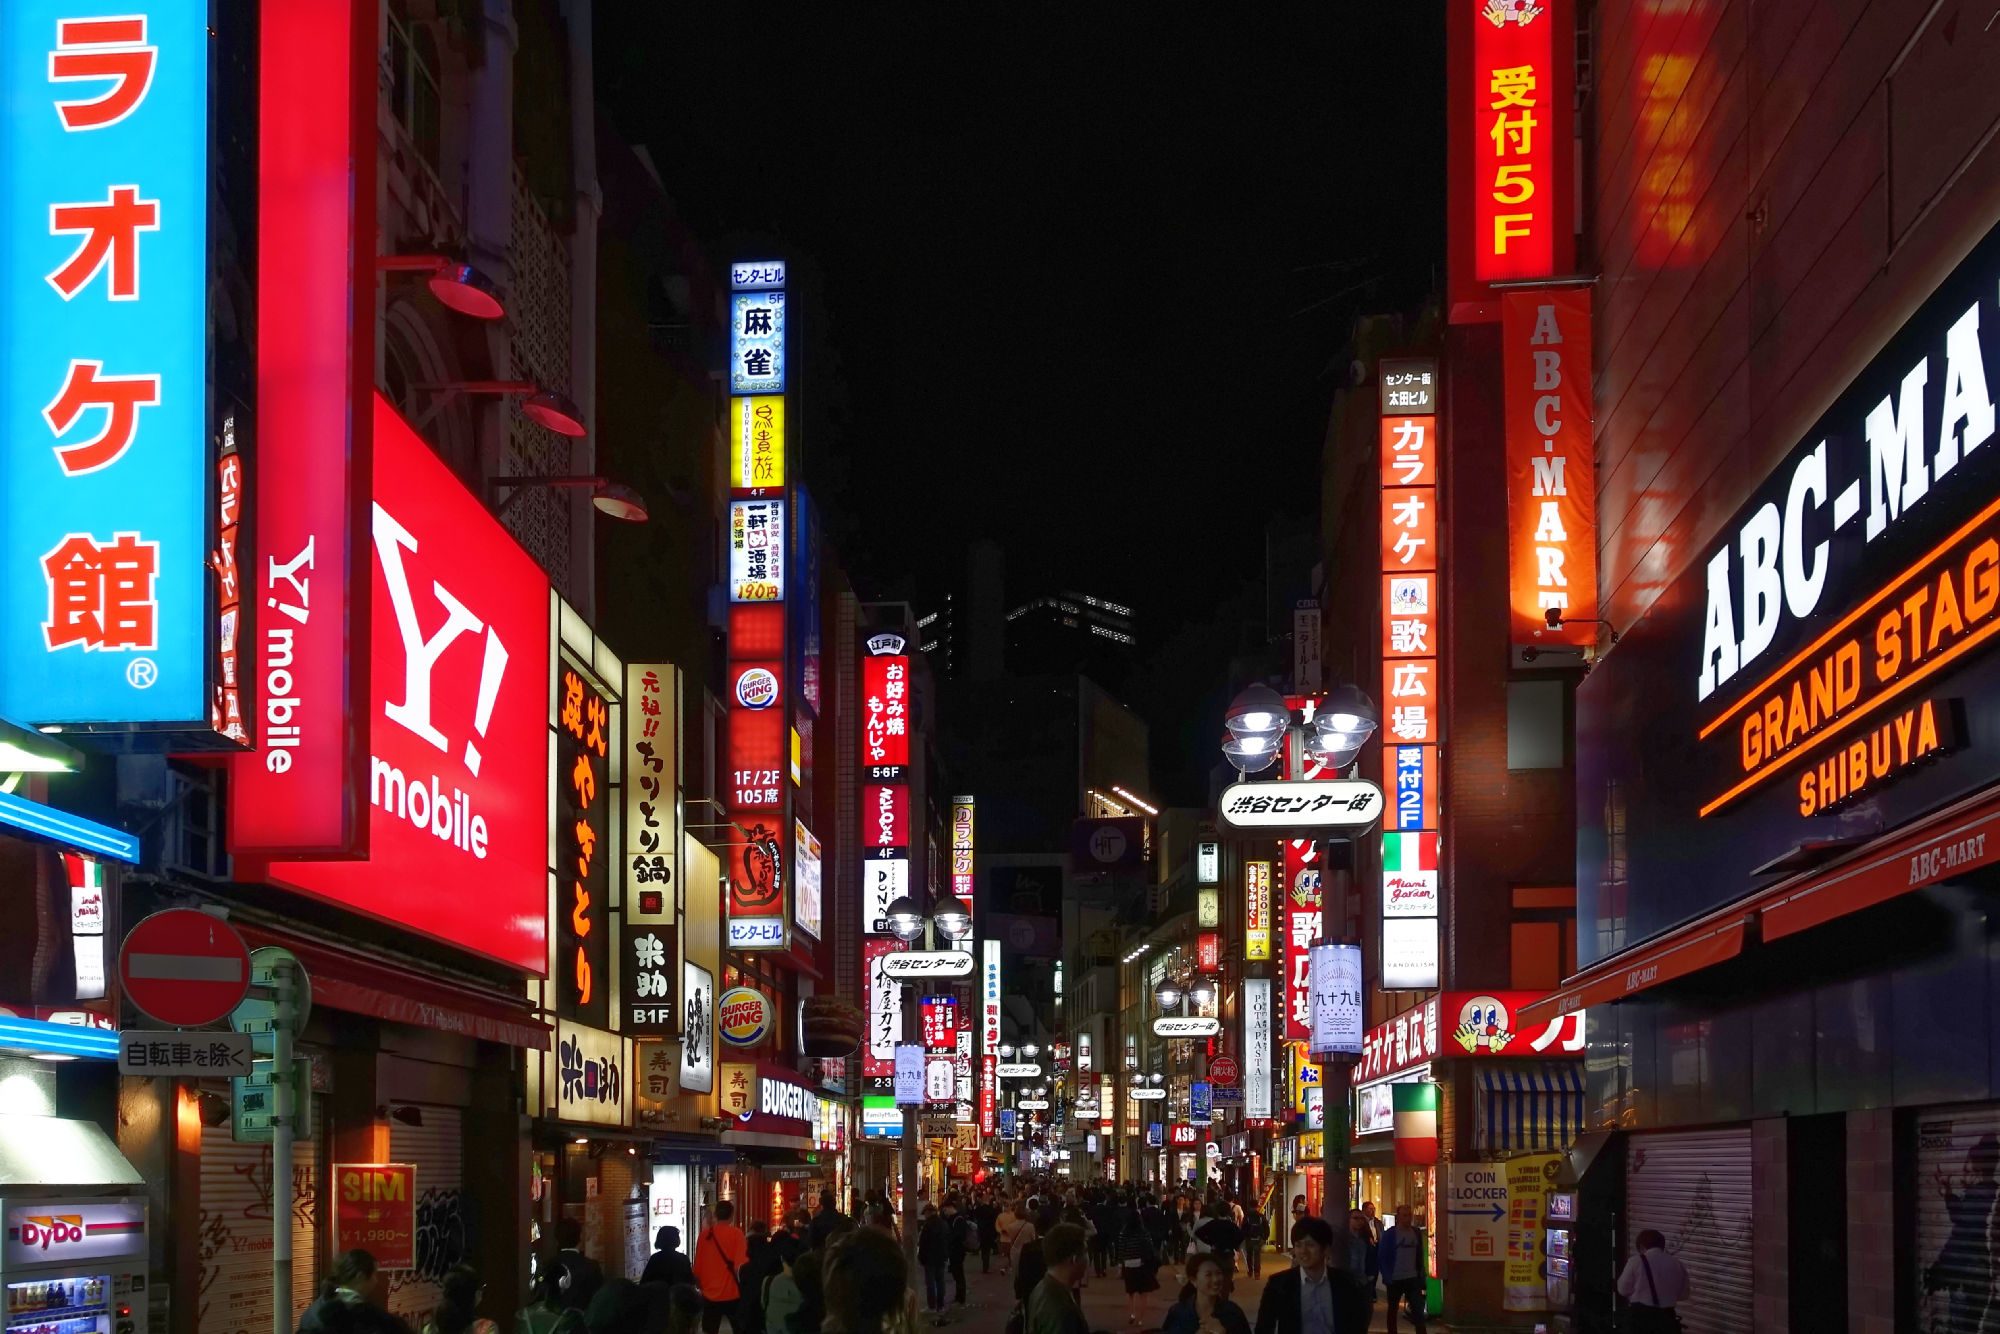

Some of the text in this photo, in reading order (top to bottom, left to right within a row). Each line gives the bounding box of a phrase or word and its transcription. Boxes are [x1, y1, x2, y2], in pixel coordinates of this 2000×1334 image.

[1490, 65, 1537, 255] 受付5F
[733, 268, 783, 284] センタービル
[769, 294, 784, 304] 5F
[42, 14, 161, 653] ラオケ館
[744, 308, 772, 376] 麻雀
[1386, 373, 1431, 386] センター街
[1389, 391, 1428, 406] 太田ビル
[1530, 305, 1567, 631] ABC-MART
[751, 488, 766, 497] 4F
[1392, 420, 1426, 564] カラオケ
[1699, 280, 2000, 701] ABC-MA
[742, 676, 771, 691] BURGER
[743, 683, 772, 701] KING
[1391, 619, 1428, 740] 歌広場
[266, 628, 301, 774] mobile
[886, 663, 905, 735] お好み焼
[1741, 638, 1861, 772] GRAND
[867, 696, 886, 760] もんじゃ
[1800, 699, 1939, 818] SHIBUYA
[736, 790, 779, 804] 105席
[1398, 748, 1422, 828] 受付2F
[371, 754, 489, 860] mobile
[1228, 793, 1375, 814] 渋谷センター街
[879, 848, 894, 858] 4F
[955, 806, 972, 873] カラオケ
[1909, 834, 1986, 885] ABC-MART
[1387, 878, 1427, 888] Miami
[731, 925, 782, 940] センタービル
[634, 933, 669, 998] 米助
[887, 958, 969, 970] 渋谷センター街
[1626, 965, 1657, 991] ABC-MART
[633, 1009, 670, 1024] B1F
[720, 1001, 762, 1017] BURGER
[721, 1011, 763, 1031] KING
[126, 1041, 246, 1071] 自転車を除く
[648, 1050, 672, 1096] 寿司
[730, 1070, 748, 1109] 寿司
[762, 1078, 803, 1120] BURGER
[1175, 1127, 1196, 1142] ASB
[344, 1171, 405, 1201] SIM
[1465, 1171, 1496, 1184] COIN
[1456, 1187, 1507, 1200] LOCKER
[22, 1217, 83, 1250] DyDo
